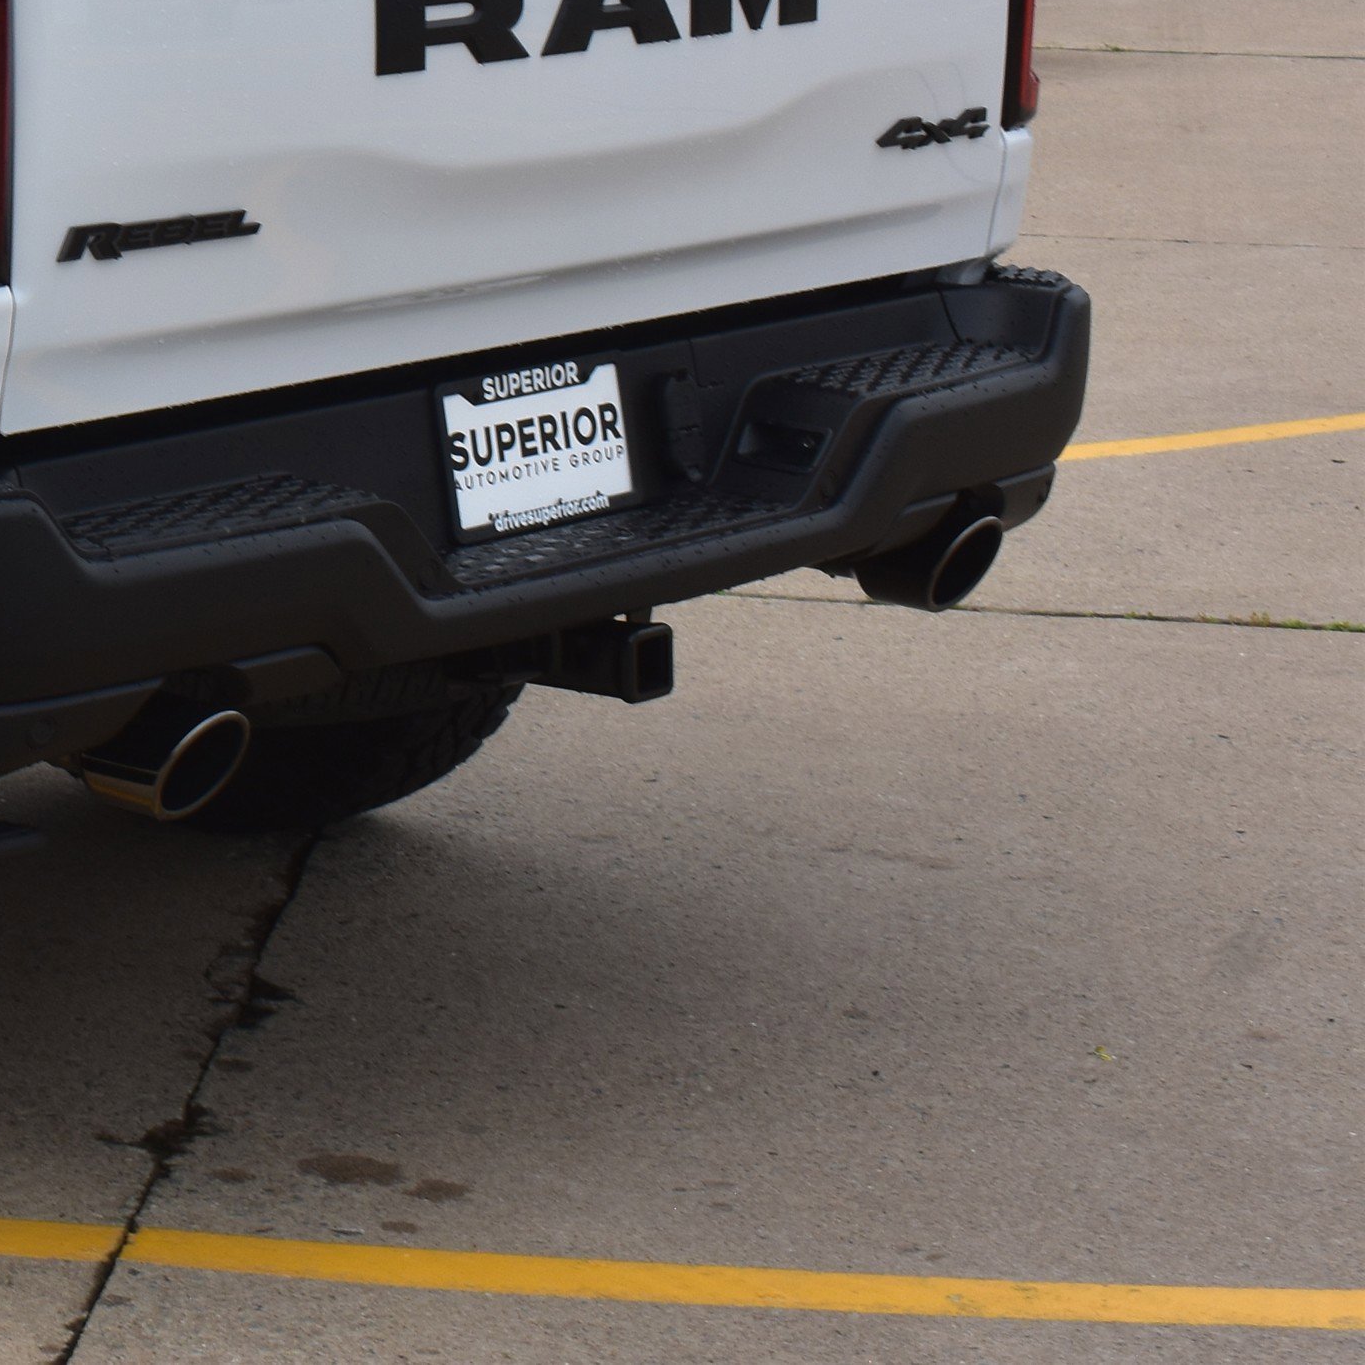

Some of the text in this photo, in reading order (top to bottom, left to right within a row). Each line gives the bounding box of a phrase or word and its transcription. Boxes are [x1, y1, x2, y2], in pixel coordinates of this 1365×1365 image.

[875, 105, 991, 151] 4x4
[55, 208, 263, 264] REBEL
[481, 360, 581, 402] SUPERIOR
[448, 402, 624, 472] SUPERIOR
[453, 444, 626, 493] AUTOMOTIVE GROUP
[492, 493, 611, 533] drivesuperior.com
